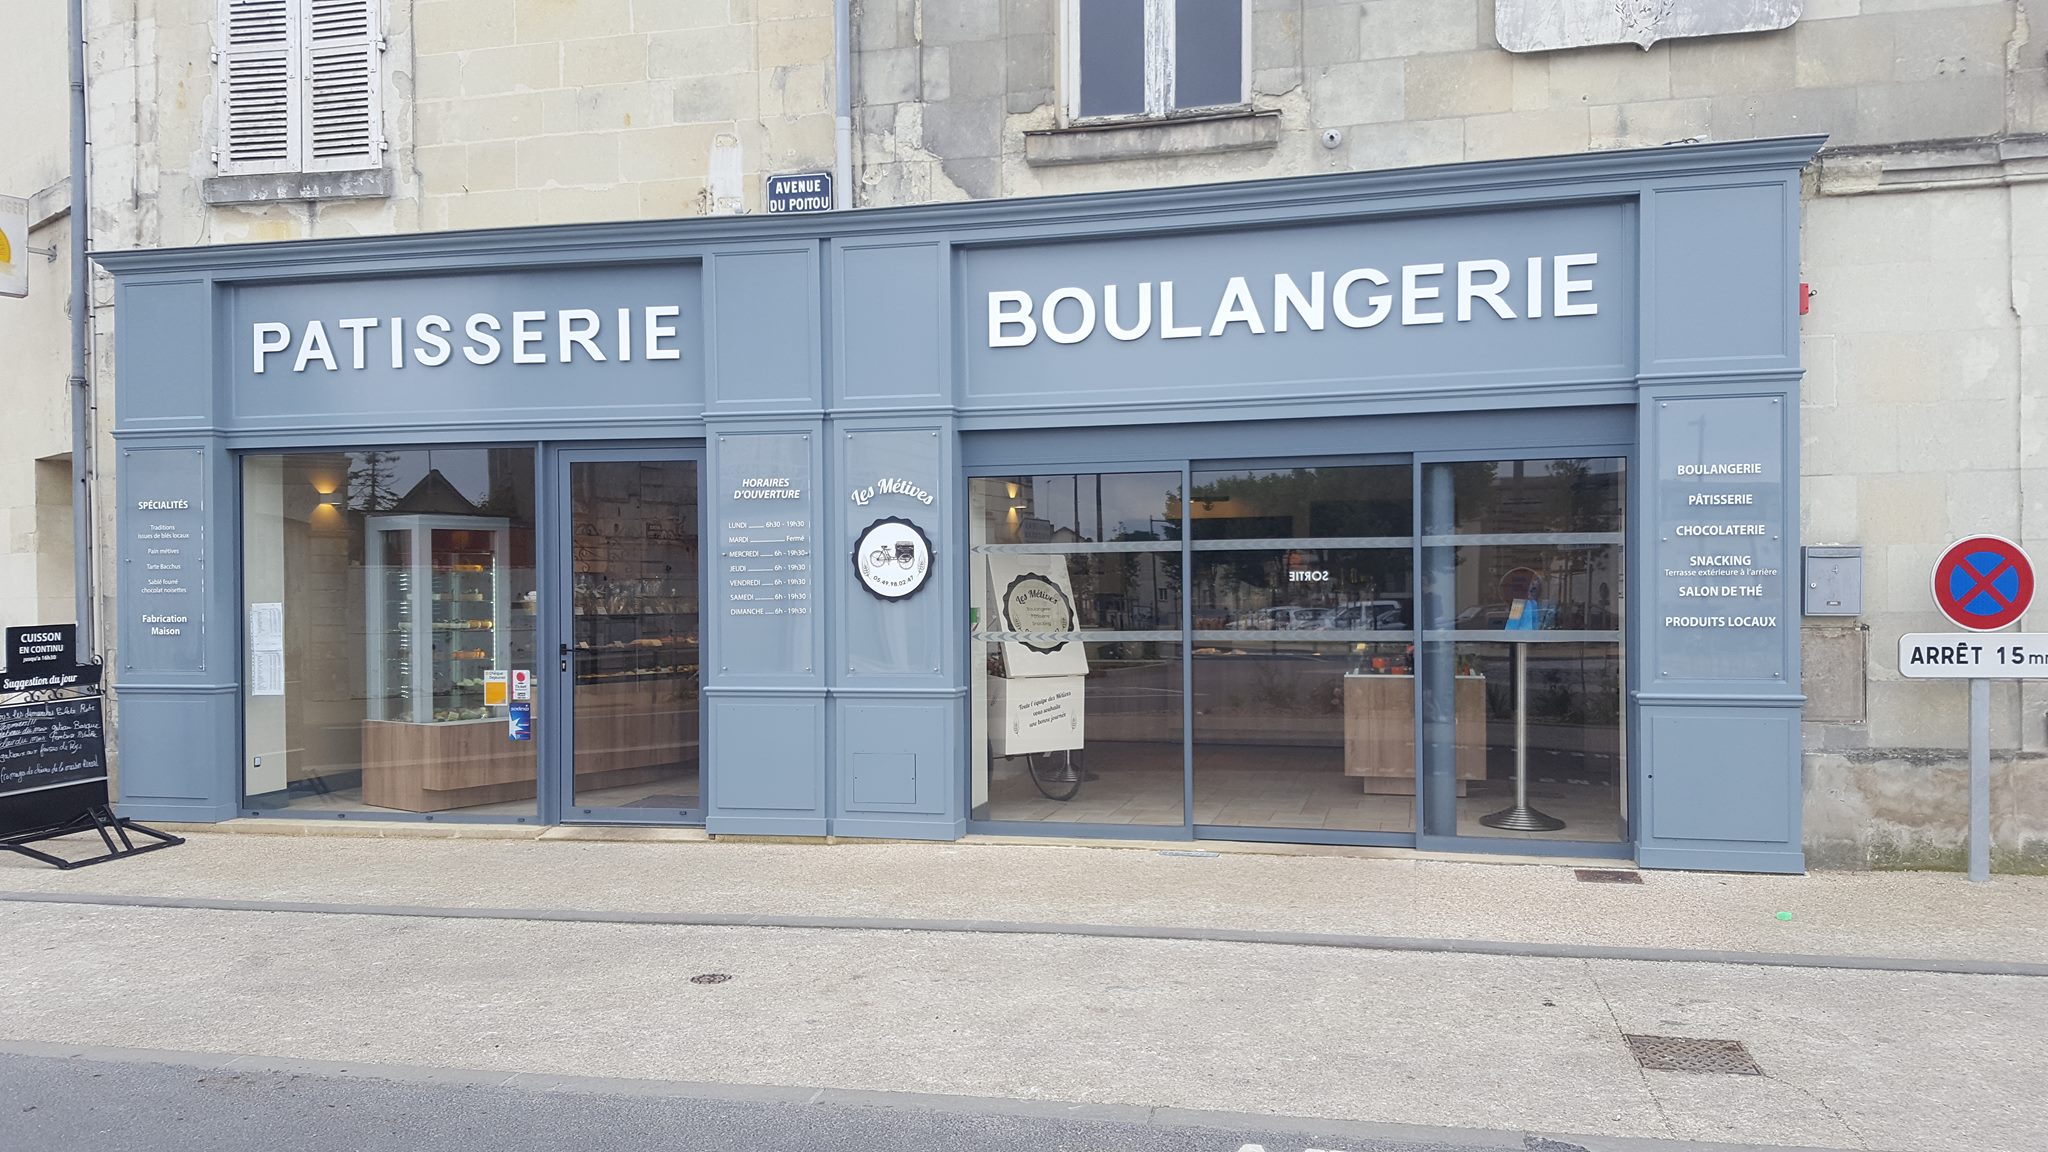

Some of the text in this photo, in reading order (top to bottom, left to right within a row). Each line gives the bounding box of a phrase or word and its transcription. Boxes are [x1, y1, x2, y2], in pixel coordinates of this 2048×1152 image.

[775, 179, 821, 195] AVENUE
[769, 196, 829, 212] DU POITOU
[987, 252, 1599, 349] BOULANGERIE
[252, 305, 682, 374] PATISSERIE
[1677, 463, 1762, 475] BOULANGERIE
[742, 478, 790, 488] HORAIRES
[733, 489, 801, 500] D'OUVERTURE
[851, 478, 934, 506] Les Métives
[138, 499, 189, 510] SPÉCIALITÉS
[1688, 493, 1753, 505] PÂTISSERIE
[1676, 524, 1765, 536] CHOCOLATERIE
[1690, 555, 1751, 566] SNACKING
[1665, 568, 1777, 577] Terrasse extérieure à l'arrière
[729, 579, 761, 587] VENDREDI
[1679, 584, 1763, 597] SALON DE THÉ
[1015, 589, 1058, 605] Les Métives
[142, 614, 188, 623] Fabrication
[1665, 616, 1777, 627] PRODUITS LOCAUX
[151, 626, 181, 636] Maison
[20, 632, 62, 643] CUISSON
[19, 644, 64, 654] EN CONTINU
[1910, 642, 1983, 665] ARRÊT
[3, 673, 78, 691] Suggestion du jour
